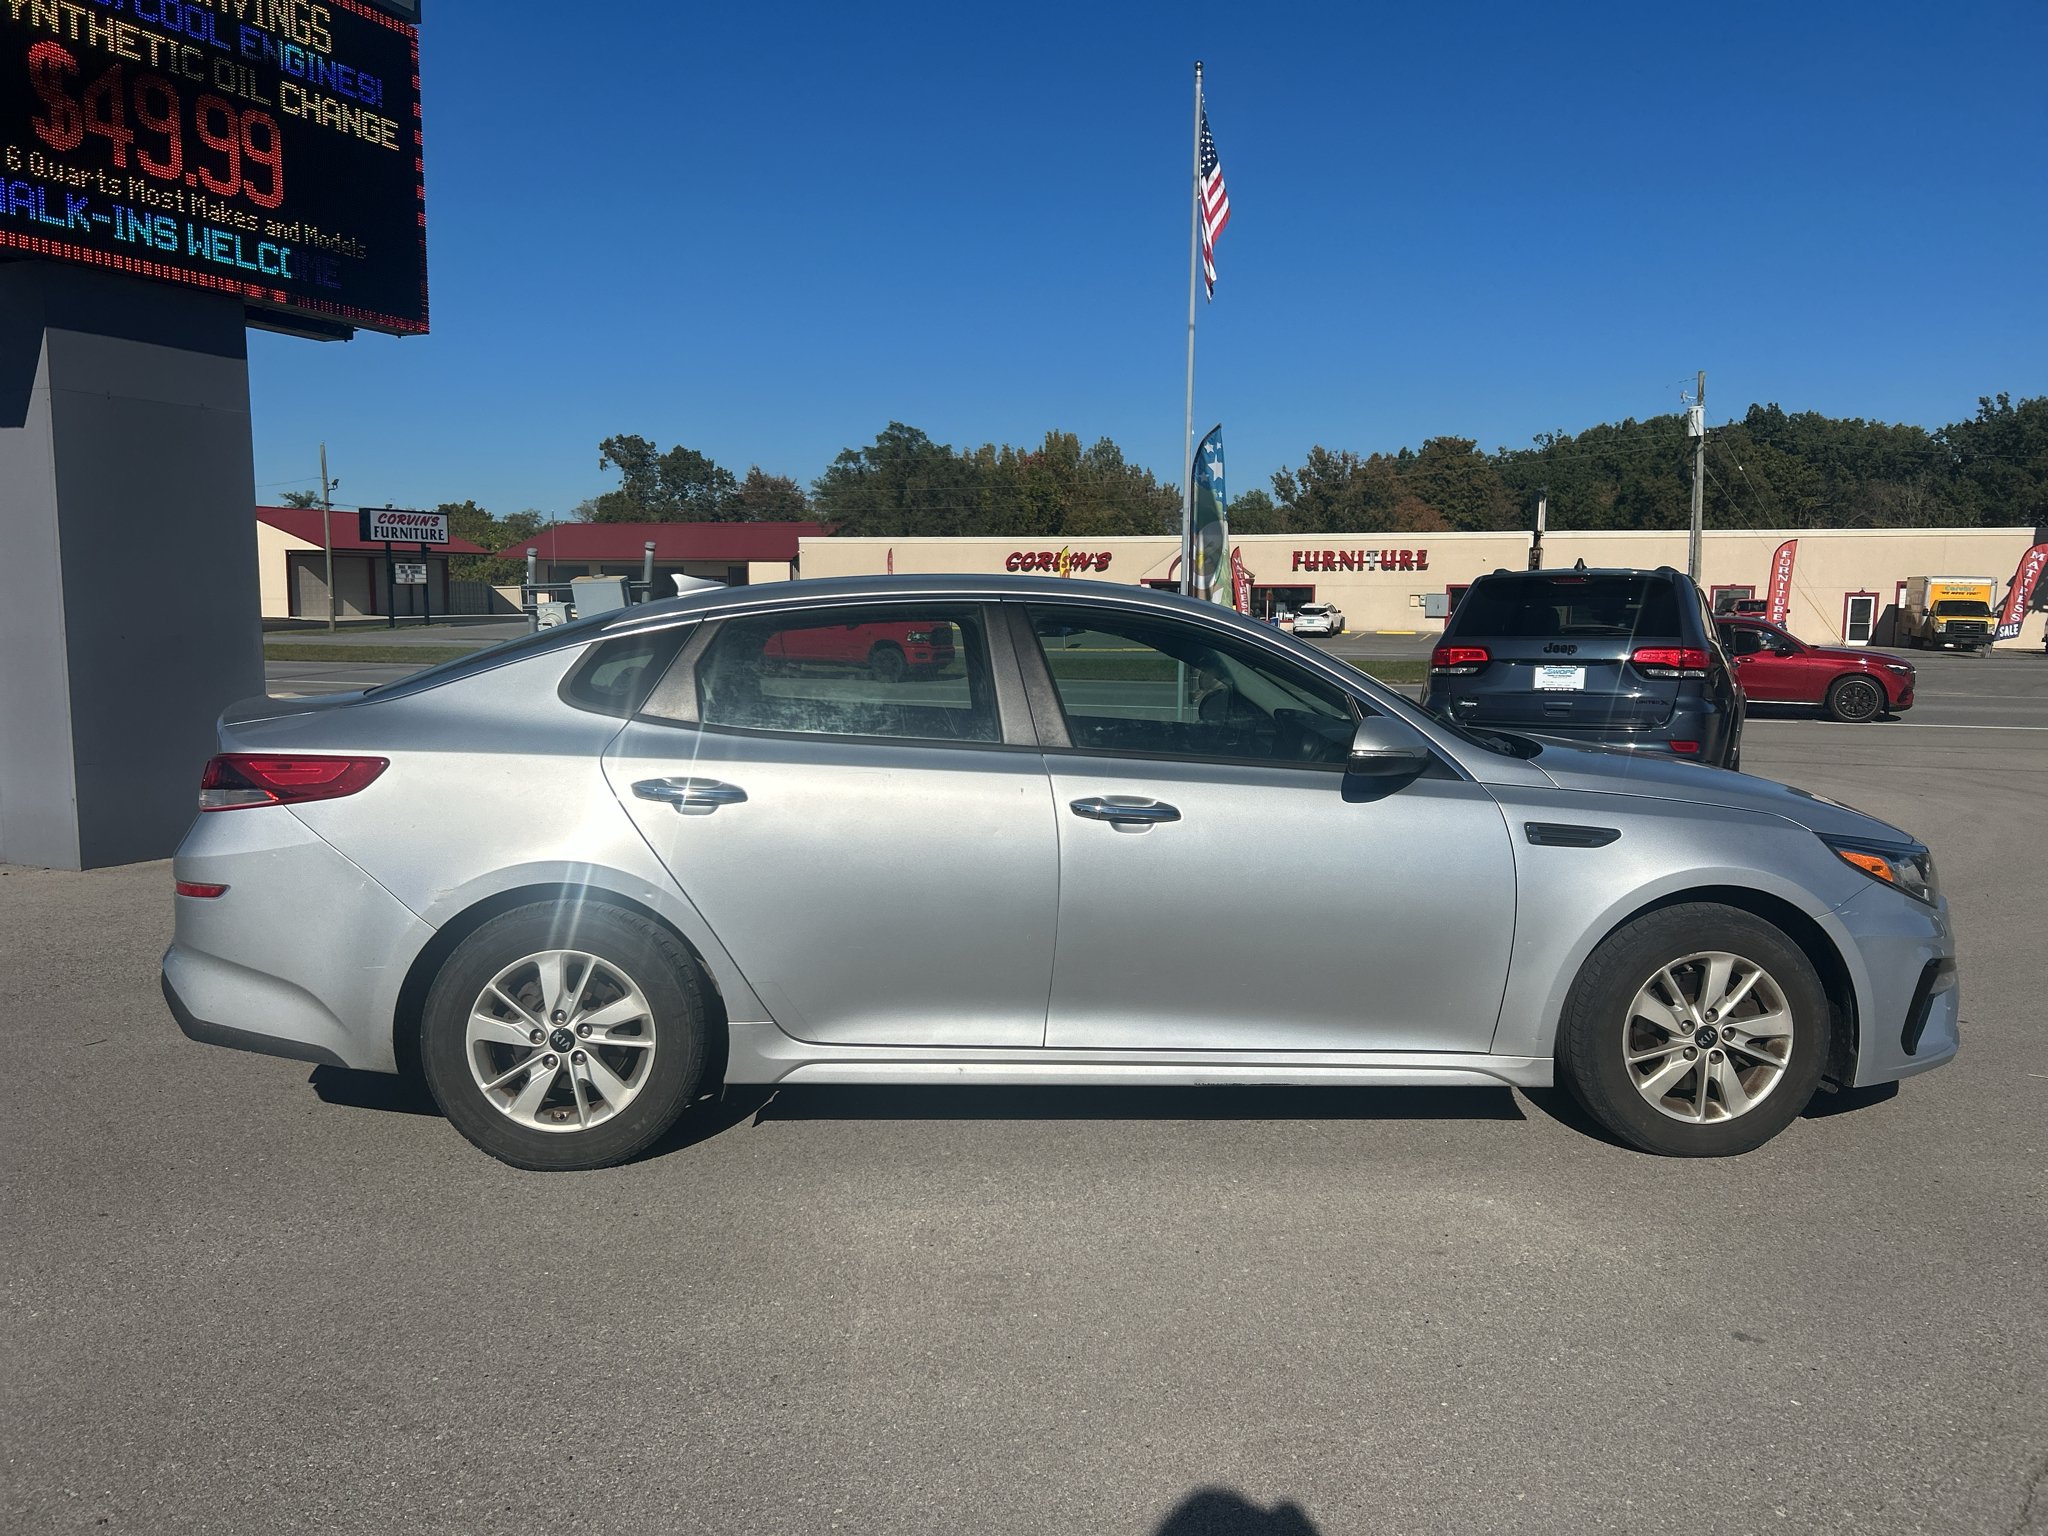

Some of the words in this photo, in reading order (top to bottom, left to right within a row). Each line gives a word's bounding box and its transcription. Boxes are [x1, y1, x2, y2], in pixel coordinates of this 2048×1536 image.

[239, 24, 383, 109] ENGINES!
[28, 40, 284, 209] $49.99
[214, 57, 272, 107] OIL
[280, 80, 400, 151] CHANGE
[0, 177, 178, 251] ALK-INS
[6, 145, 21, 171] 6
[30, 151, 122, 196] Quarts
[129, 176, 185, 213] Most
[191, 193, 258, 232] Makes
[265, 219, 300, 242] and
[304, 223, 367, 260] Models
[374, 526, 445, 540] FURNITURE
[378, 513, 440, 527] CORVIN'S
[1291, 549, 1430, 572] FURNITURE
[1772, 550, 1792, 621] FURNITURE
[2010, 550, 2047, 622] MATTRESS
[1543, 642, 1578, 656] Jeep
[1999, 623, 2020, 638] SALE
[552, 1032, 570, 1049] KIA
[1698, 1030, 1716, 1046] KIA
